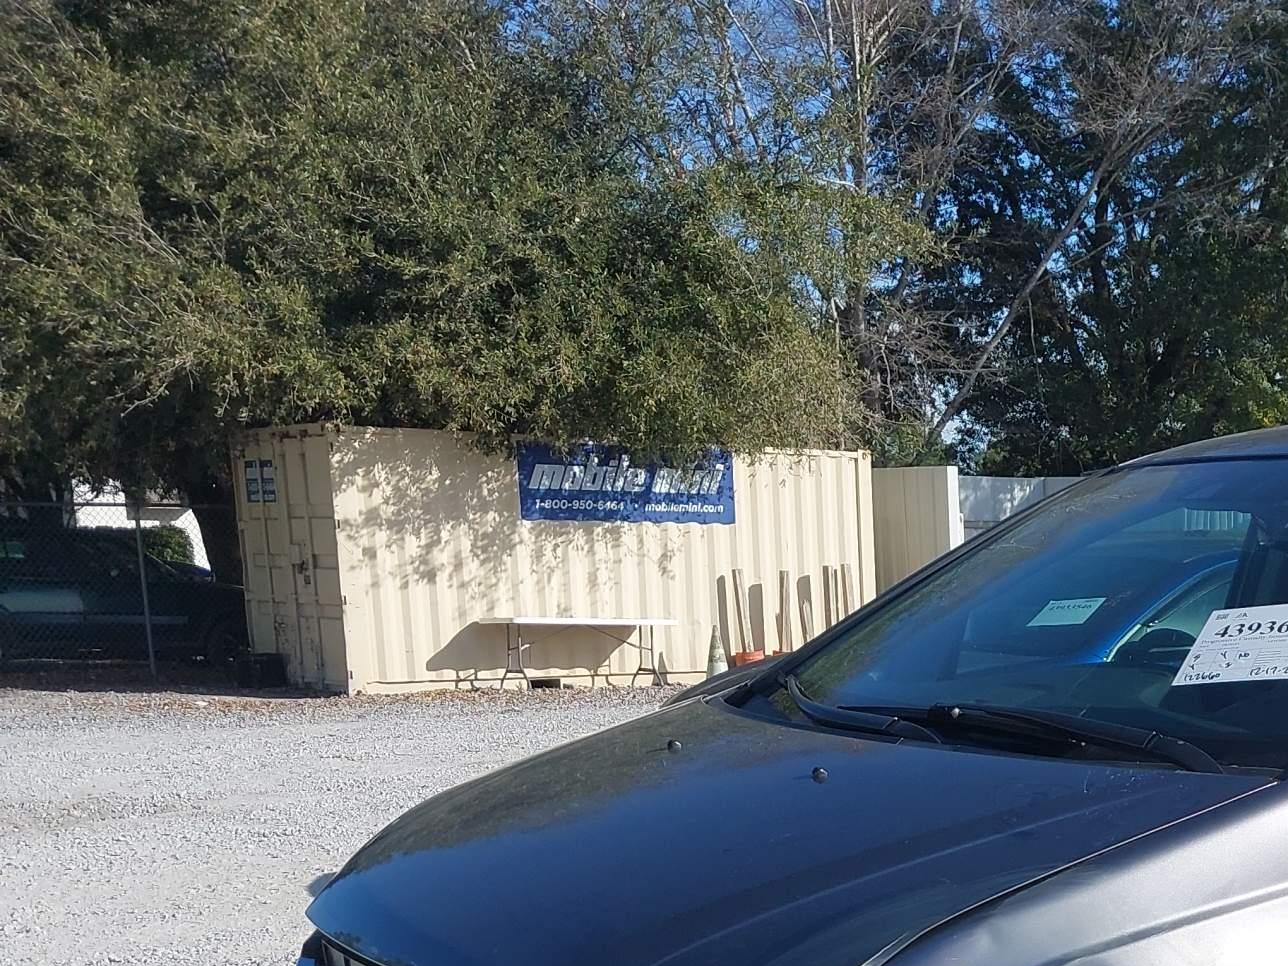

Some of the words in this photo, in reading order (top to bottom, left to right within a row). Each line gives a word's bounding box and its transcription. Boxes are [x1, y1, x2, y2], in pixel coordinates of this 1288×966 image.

[528, 454, 645, 491] mobile
[534, 499, 624, 511] 1-800-950-6464
[645, 502, 724, 513] mobilemini.com
